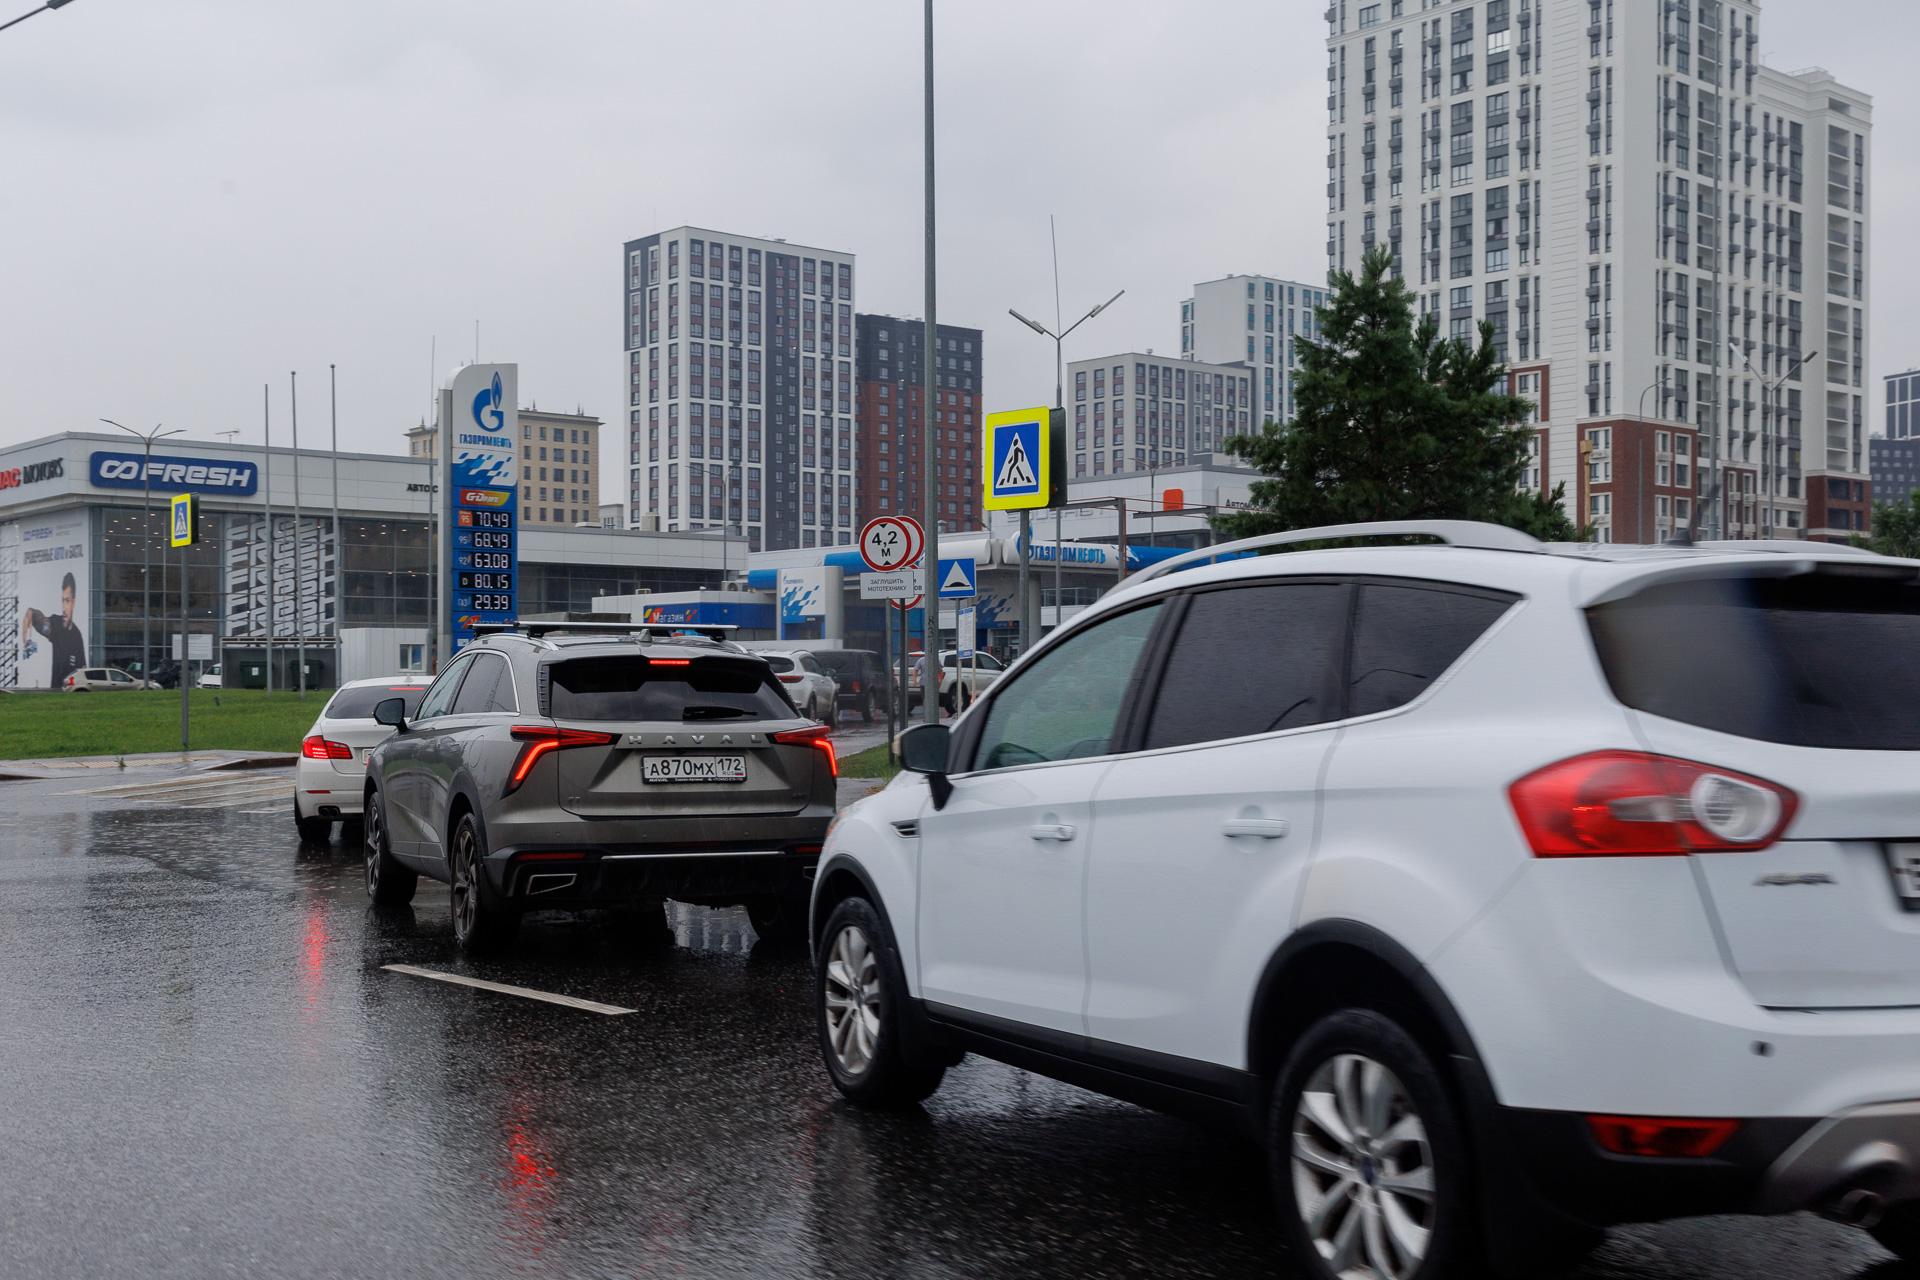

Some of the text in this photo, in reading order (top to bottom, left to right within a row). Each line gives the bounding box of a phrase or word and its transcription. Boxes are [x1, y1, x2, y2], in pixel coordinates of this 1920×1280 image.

[23, 457, 64, 484] MOTORS
[476, 511, 509, 528] 70.49
[474, 532, 509, 548] 68.49
[871, 530, 898, 547] 4,2
[474, 553, 509, 569] 63.08
[1034, 545, 1106, 564] ГАЗПОМНЕФТЬ
[474, 573, 509, 589] 80.15
[474, 594, 509, 610] 29.39
[629, 735, 762, 744] HAVAL
[650, 758, 741, 776] А870МХ 172
